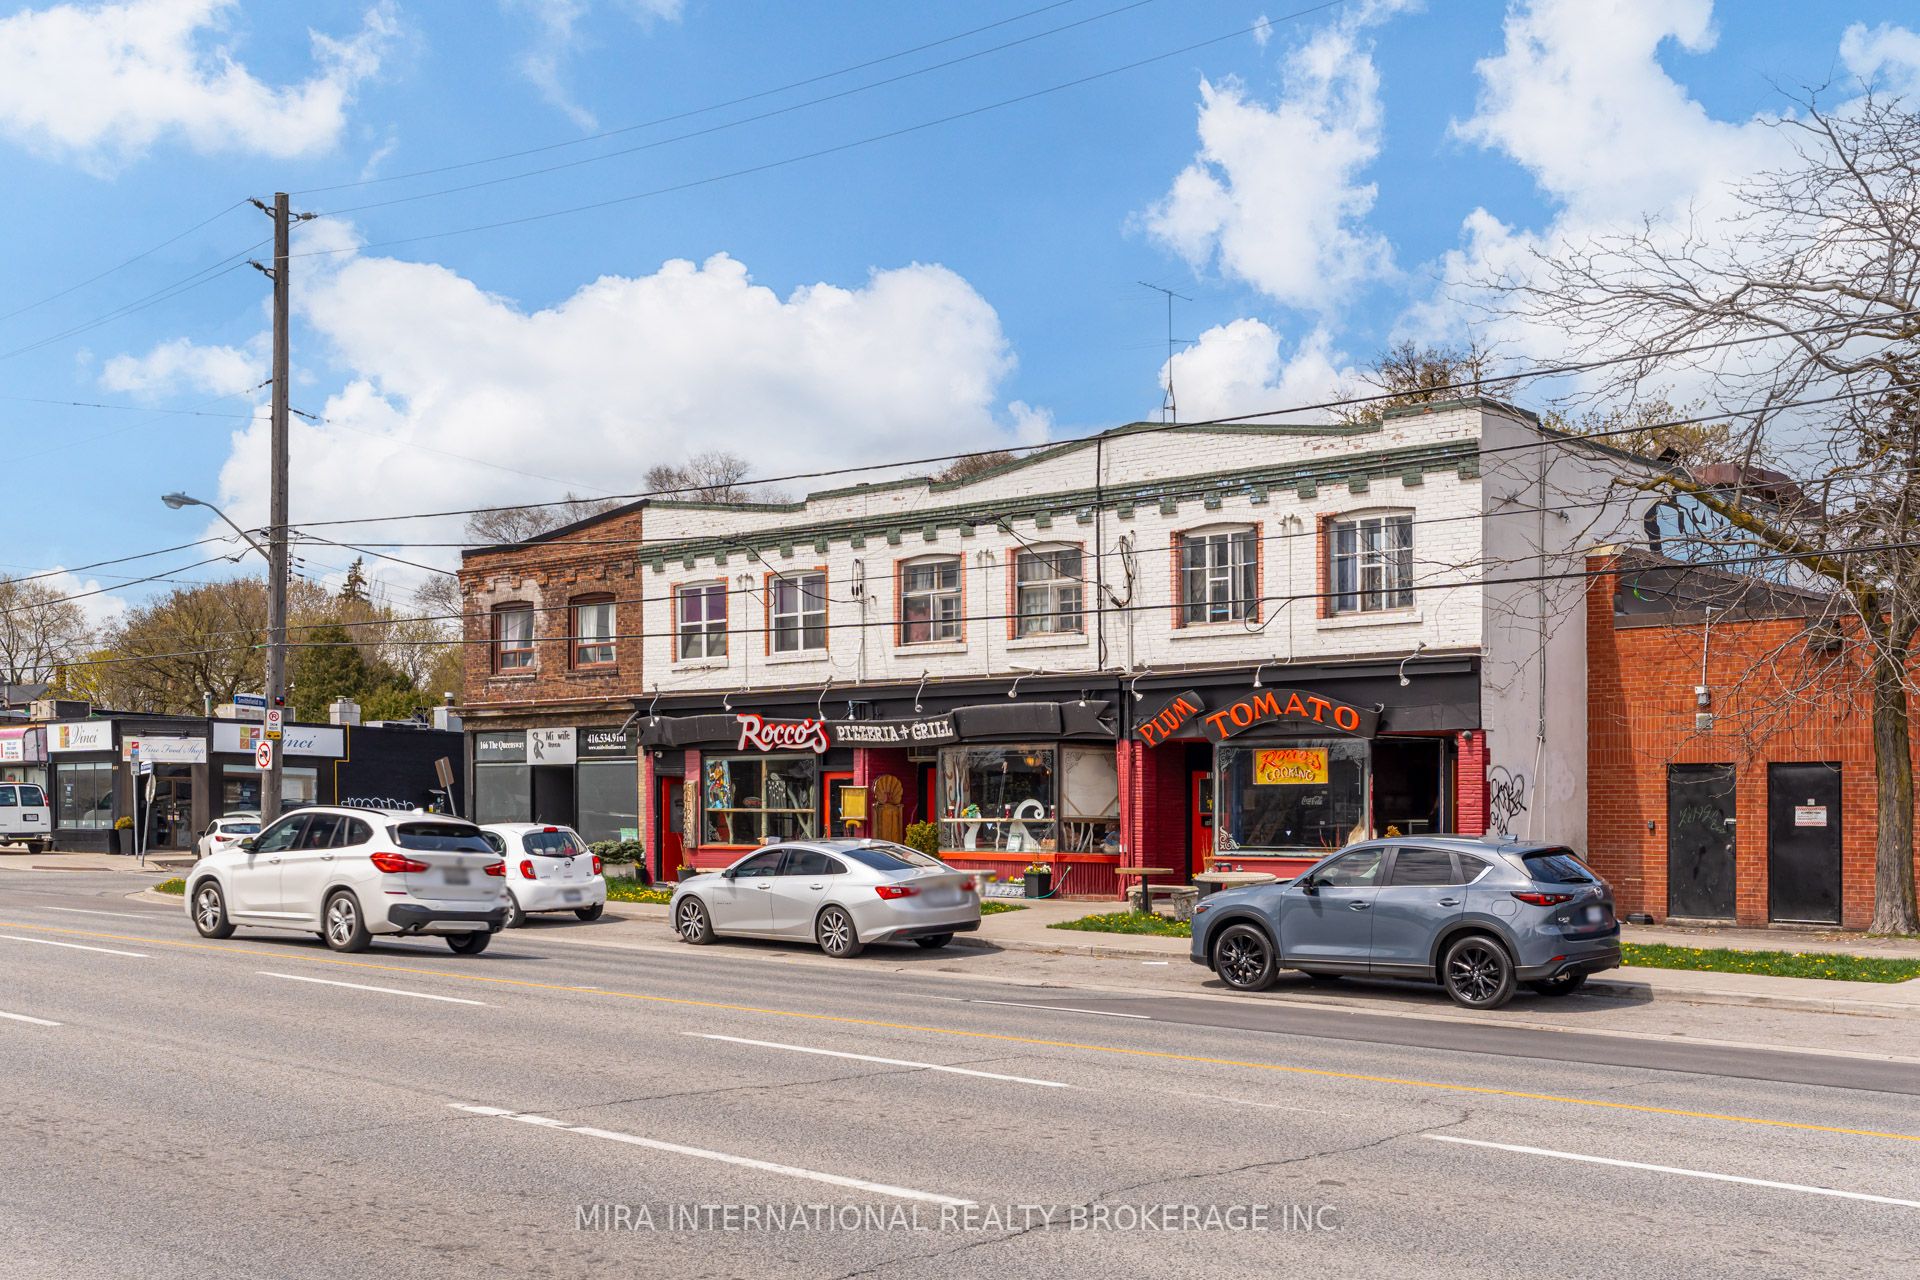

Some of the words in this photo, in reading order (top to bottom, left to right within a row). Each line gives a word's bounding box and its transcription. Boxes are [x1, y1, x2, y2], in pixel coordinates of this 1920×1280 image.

[1138, 697, 1198, 747] PLUM
[1205, 691, 1361, 739] TOMATO
[71, 725, 99, 745] Vinci
[836, 724, 900, 742] PIZZERIA
[911, 721, 953, 740] GRILL
[480, 741, 489, 750] 166
[489, 740, 498, 749] The
[498, 740, 525, 751] Queensway
[1265, 765, 1316, 783] COOKING
